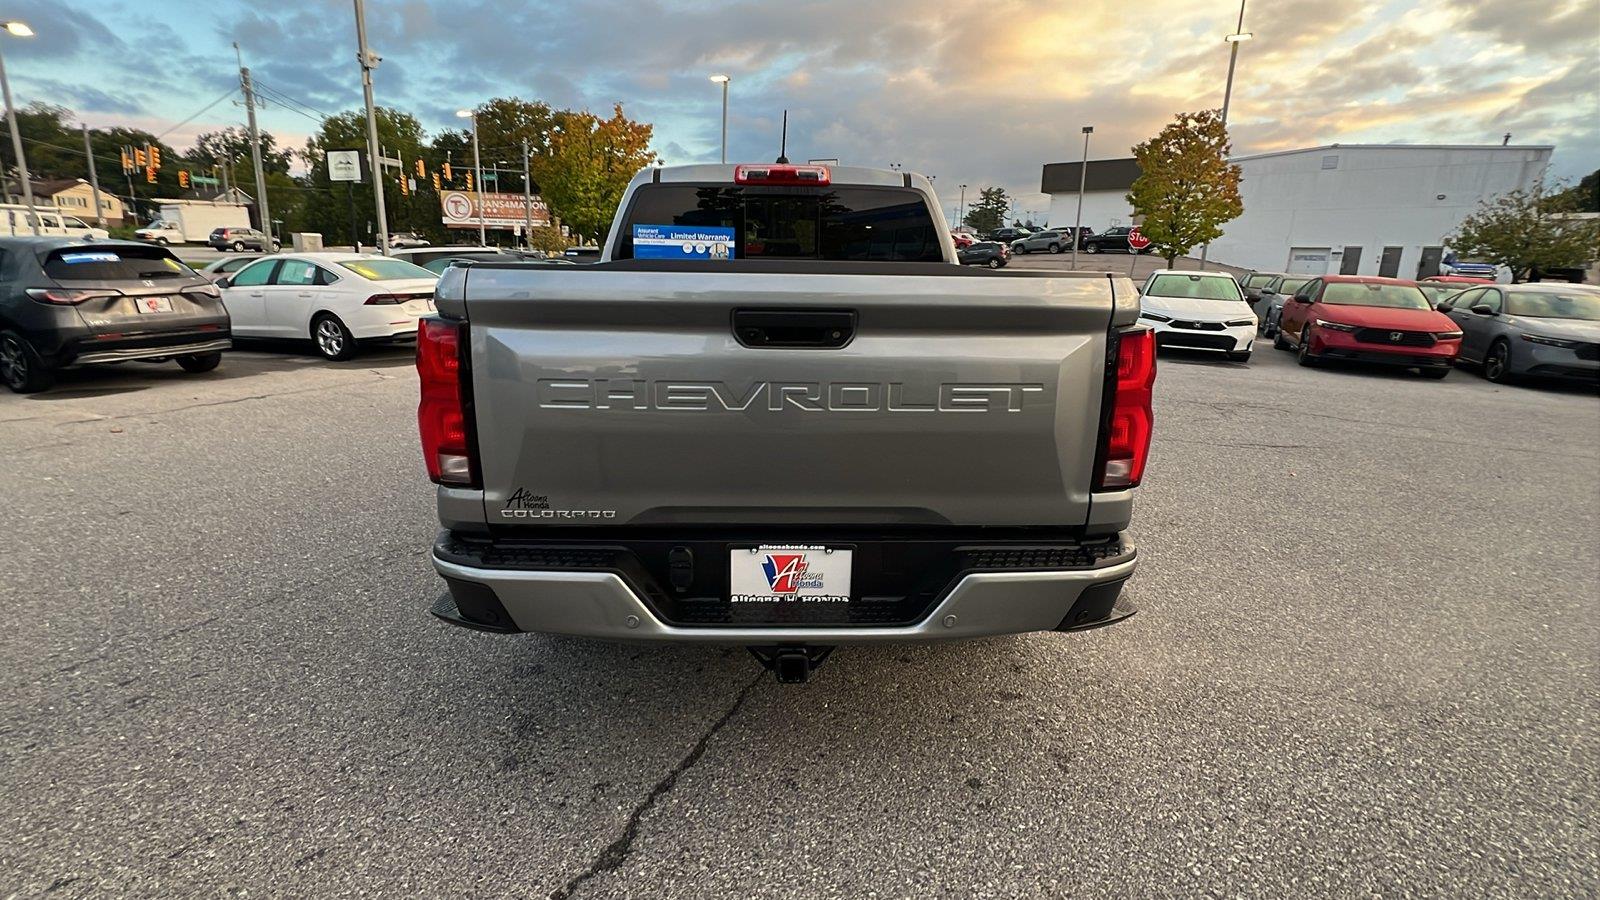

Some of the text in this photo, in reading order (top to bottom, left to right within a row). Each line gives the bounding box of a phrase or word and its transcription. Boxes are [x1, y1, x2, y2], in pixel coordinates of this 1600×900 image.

[697, 233, 730, 242] Warranty
[537, 378, 1043, 412] CHEVROLET
[506, 487, 548, 509] Altoona
[523, 501, 550, 509] Honda
[501, 510, 616, 518] COLORADO
[791, 580, 824, 589] Honda
[801, 595, 850, 603] HONDA
